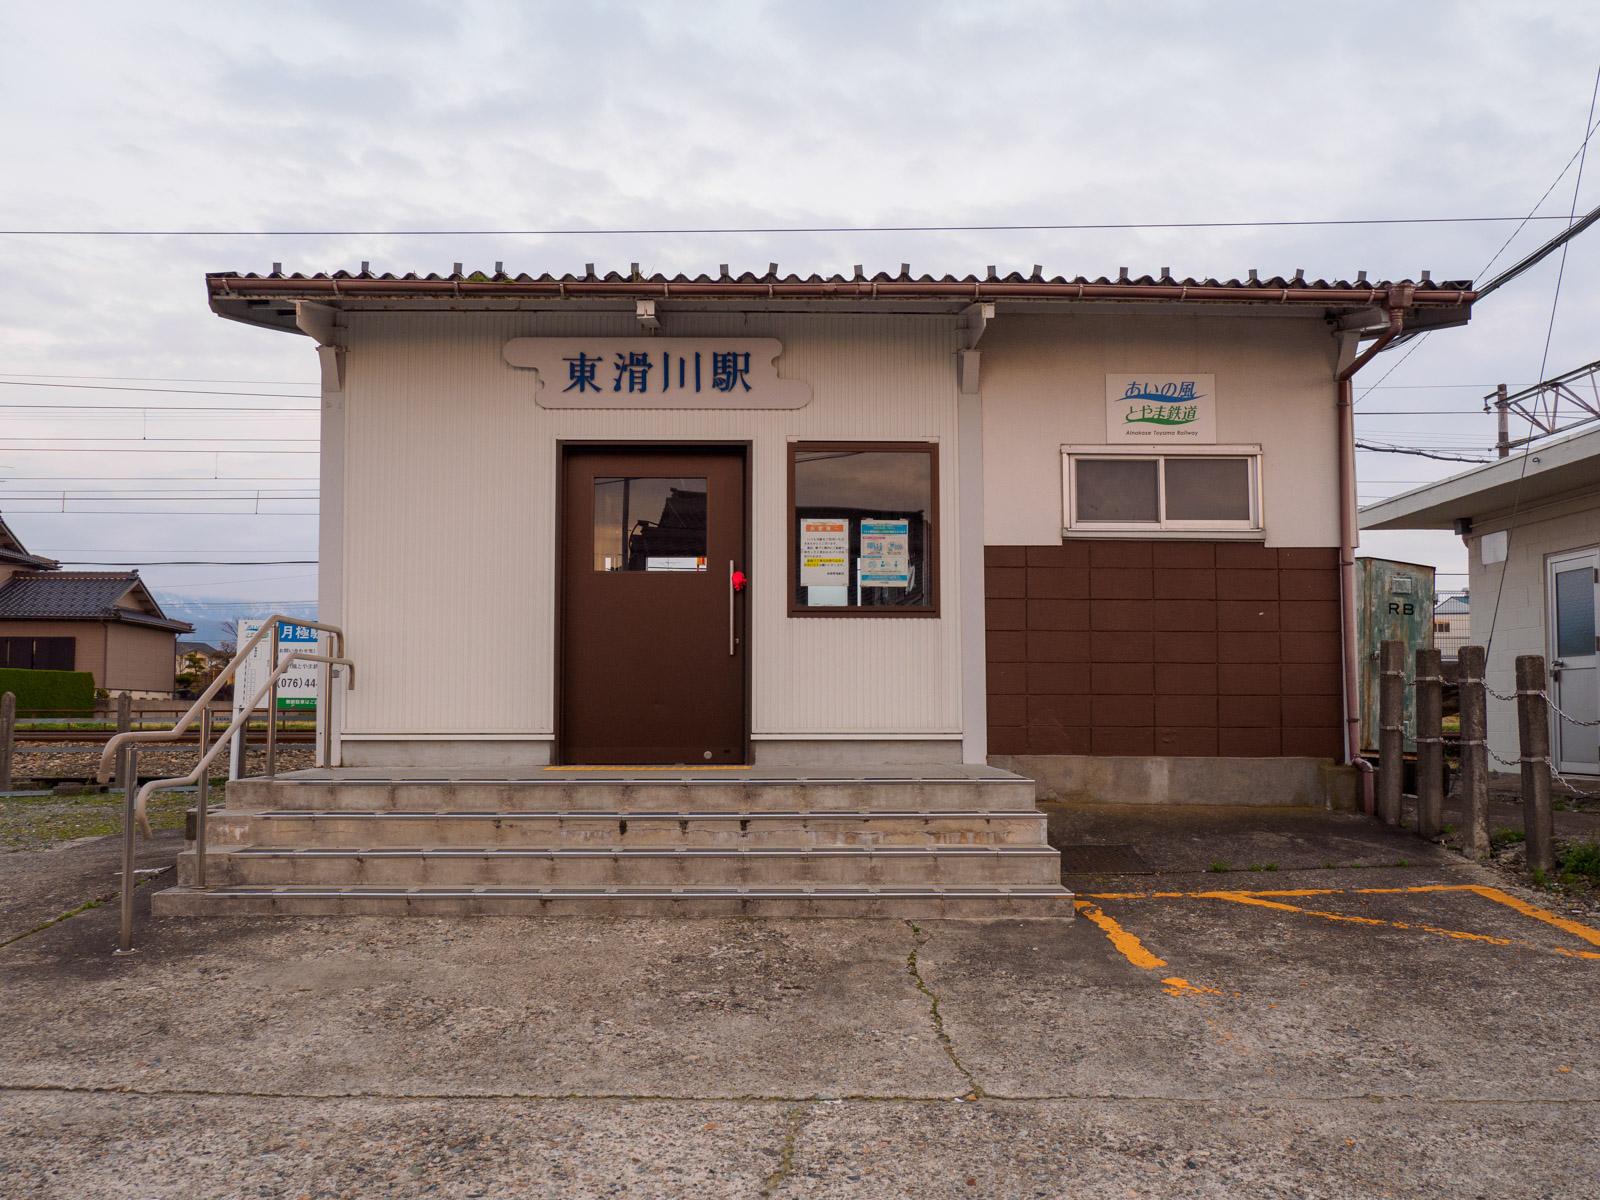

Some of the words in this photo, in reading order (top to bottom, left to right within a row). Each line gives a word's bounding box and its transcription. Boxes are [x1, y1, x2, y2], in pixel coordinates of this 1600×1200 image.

[562, 351, 752, 393] 東滑川駅
[1125, 381, 1197, 400] あいの風
[1125, 404, 1198, 421] とやま鉄道
[1389, 603, 1414, 615] RB
[277, 677, 317, 688] (076)44
